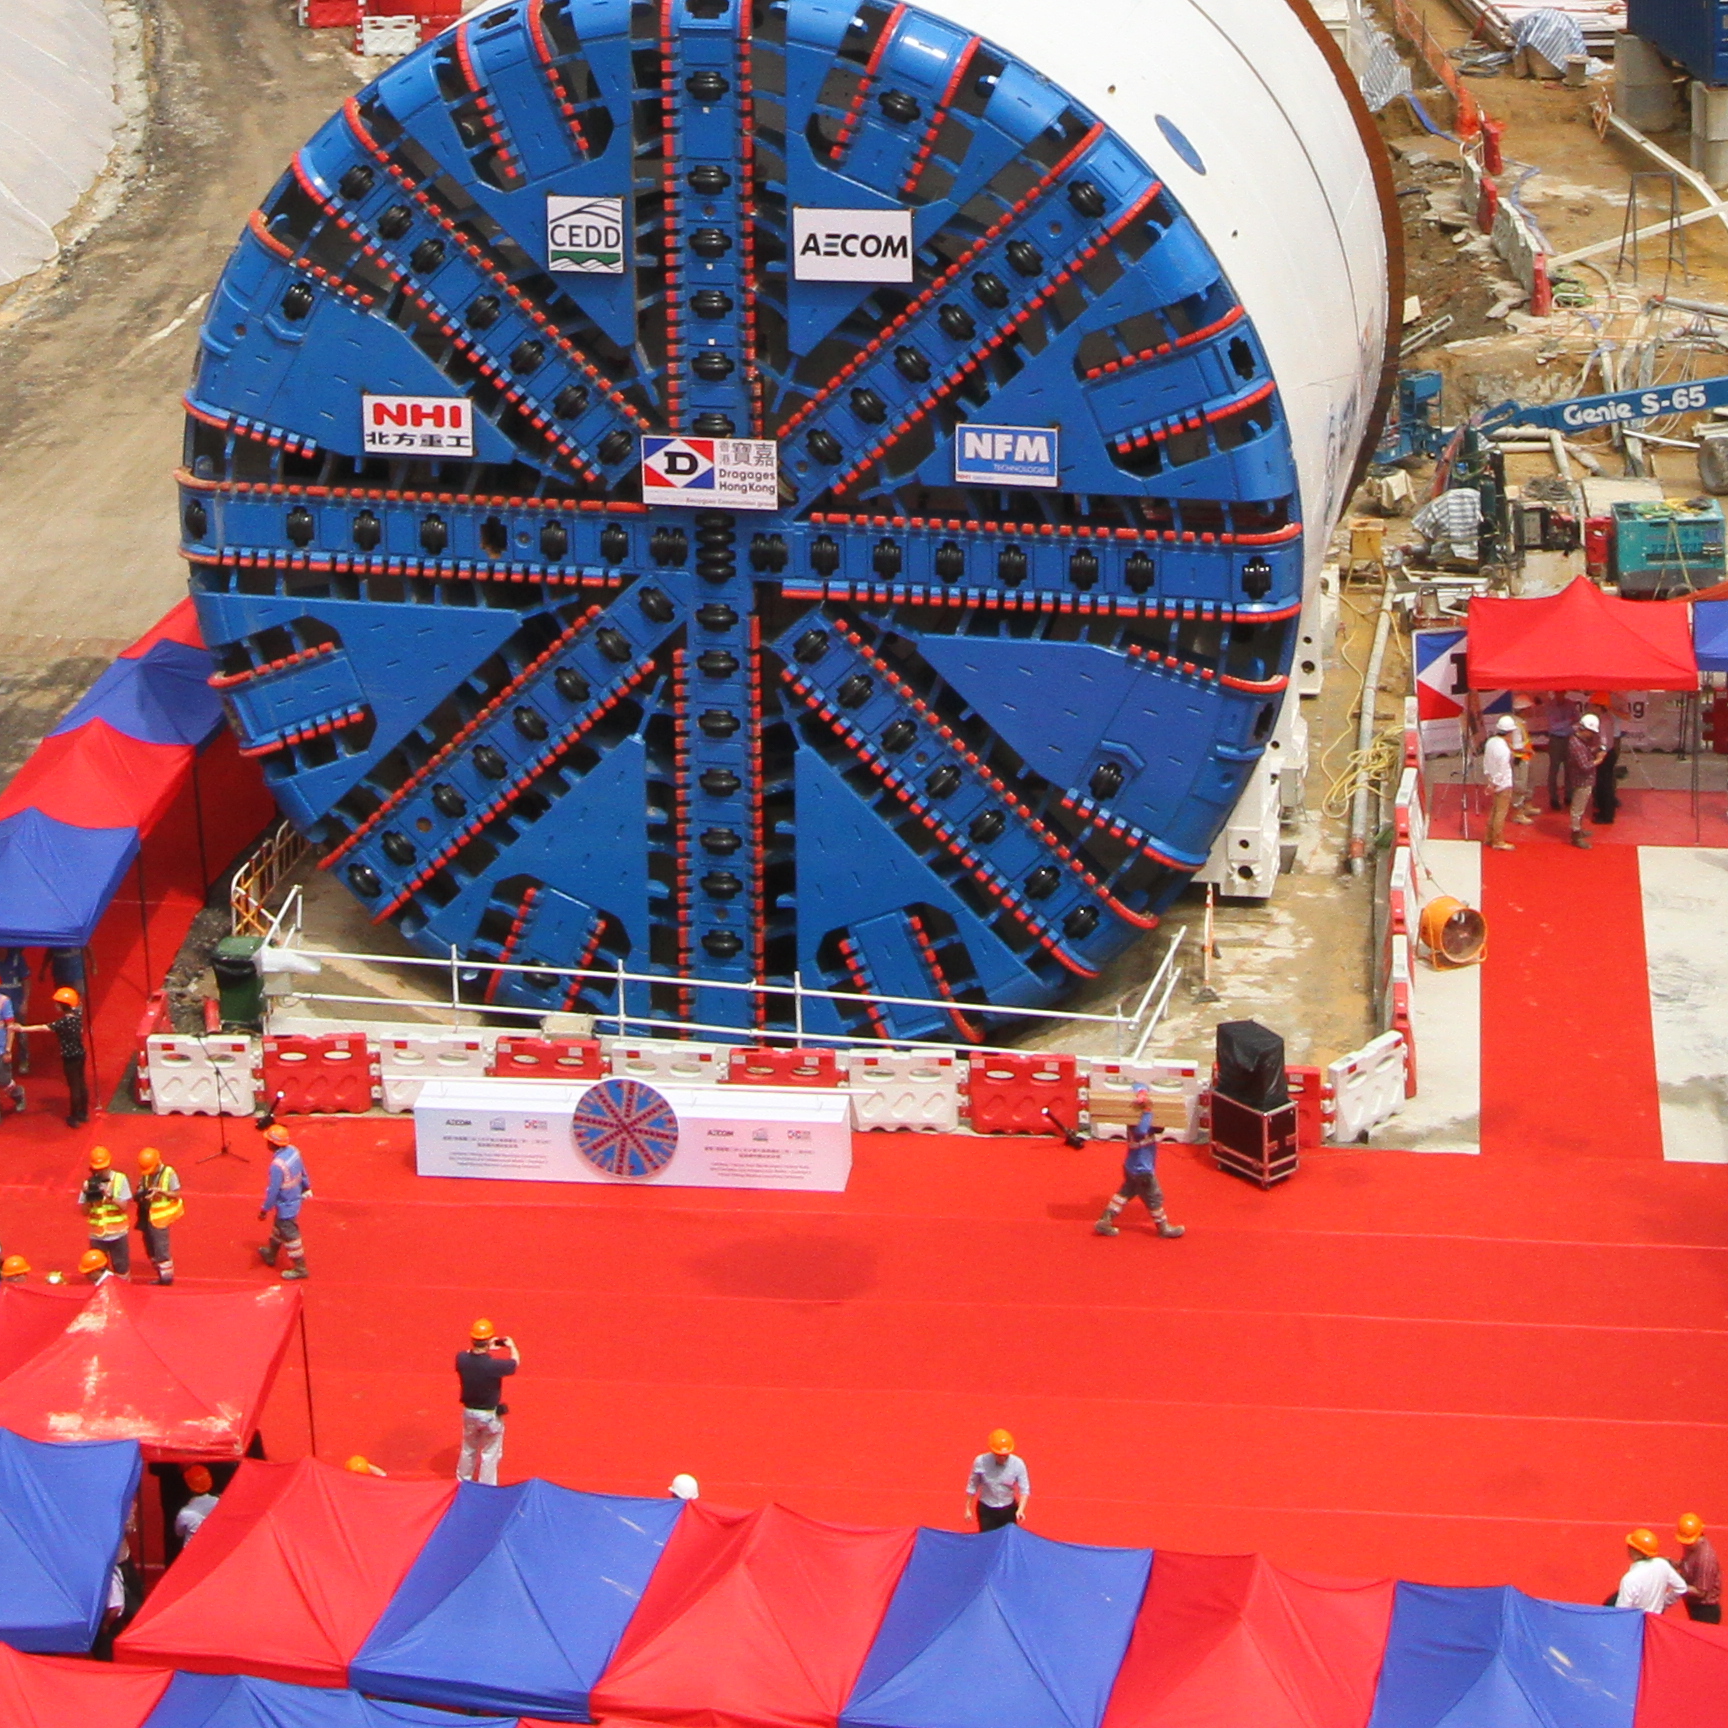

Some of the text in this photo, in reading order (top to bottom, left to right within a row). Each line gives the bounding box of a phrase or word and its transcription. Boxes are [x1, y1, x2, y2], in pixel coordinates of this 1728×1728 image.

[550, 223, 620, 249] CEDD
[800, 232, 909, 259] AECOM
[373, 402, 462, 428] NHI
[1563, 400, 1635, 426] Genie
[1641, 384, 1706, 415] S-65
[365, 431, 471, 448] 北方重工
[964, 431, 1050, 463] NFM
[663, 450, 699, 476] D
[718, 468, 776, 482] Dragages
